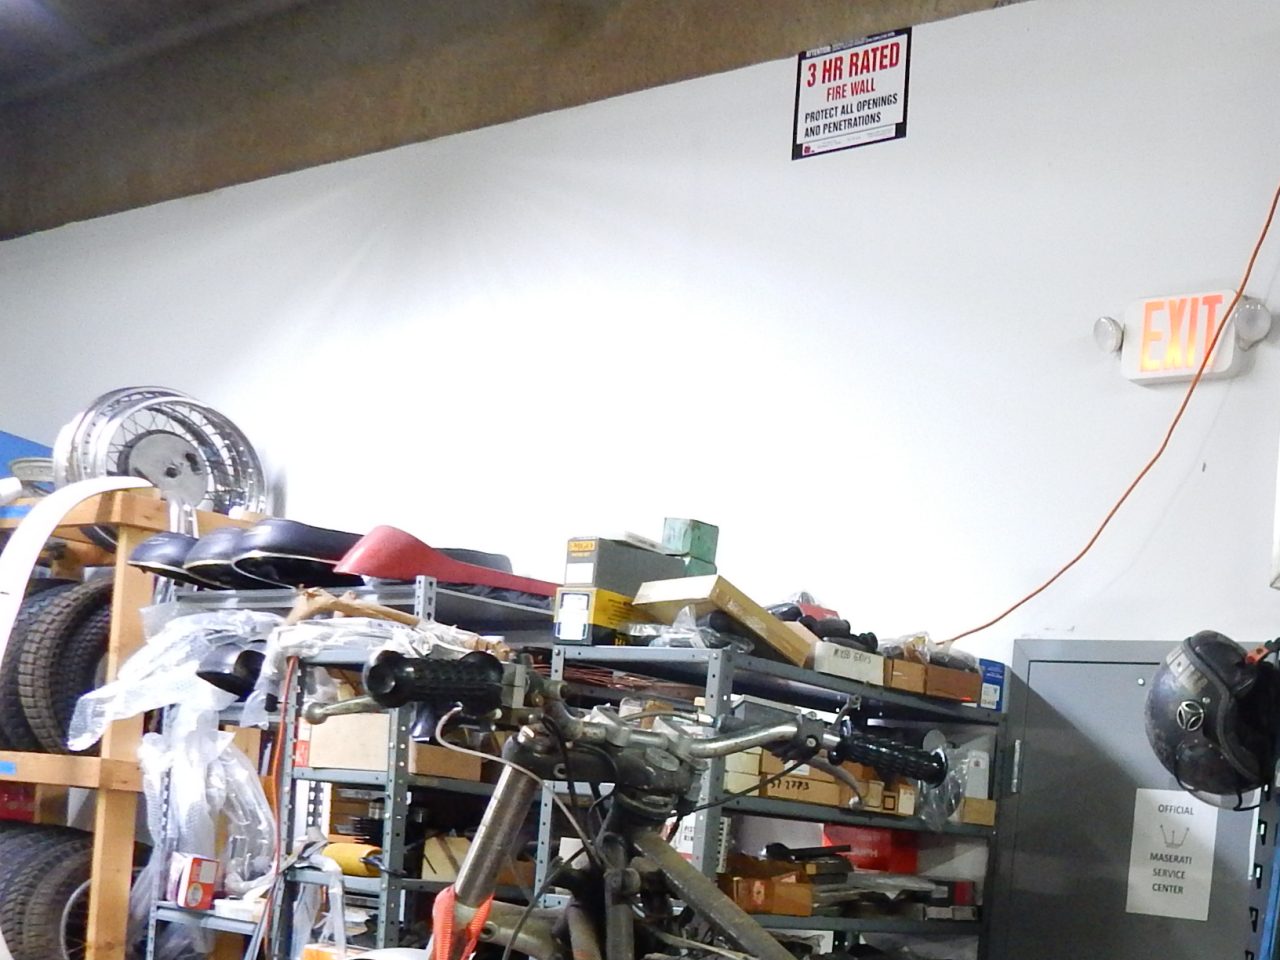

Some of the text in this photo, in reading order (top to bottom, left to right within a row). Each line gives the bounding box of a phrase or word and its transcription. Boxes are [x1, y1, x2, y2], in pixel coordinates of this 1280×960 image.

[807, 63, 817, 88] 3
[822, 56, 843, 84] HR
[849, 42, 900, 77] RATED
[827, 77, 876, 102] FIRE WALL
[805, 93, 898, 124] PROTECT ALL OPENINGS
[804, 112, 882, 138] AND PENETRATIONS
[1139, 294, 1224, 373] EXIT
[1158, 804, 1194, 815] OFFICIAL
[1150, 852, 1192, 864] MASERATI
[1152, 868, 1185, 879] SERVICE
[1152, 883, 1184, 894] CENTER
